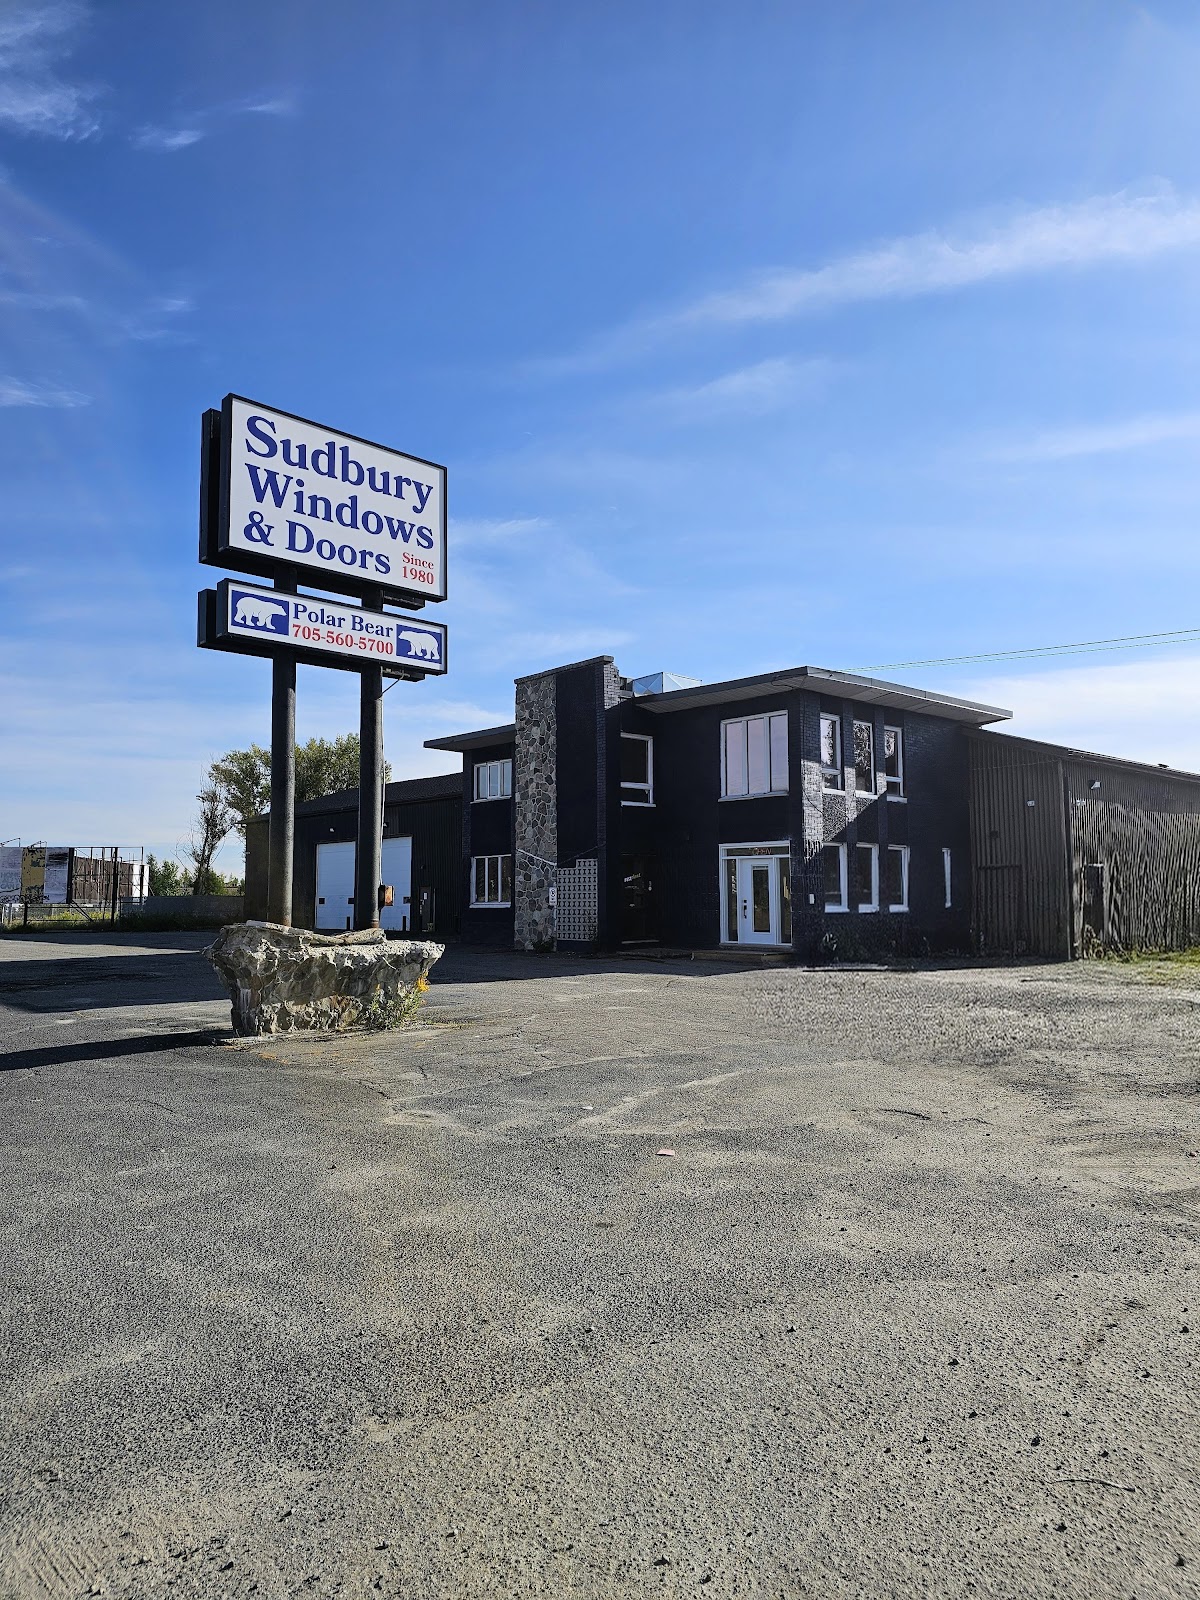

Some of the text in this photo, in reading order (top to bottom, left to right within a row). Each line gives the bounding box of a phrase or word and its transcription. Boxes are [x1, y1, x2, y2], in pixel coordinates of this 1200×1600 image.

[245, 415, 434, 514] Sudbury
[244, 463, 434, 549] Windows
[243, 510, 391, 575] & Doors
[402, 552, 434, 570] Since
[402, 566, 434, 585] 1980
[293, 603, 393, 637] Polar Bear
[292, 623, 394, 655] 705-560-5700
